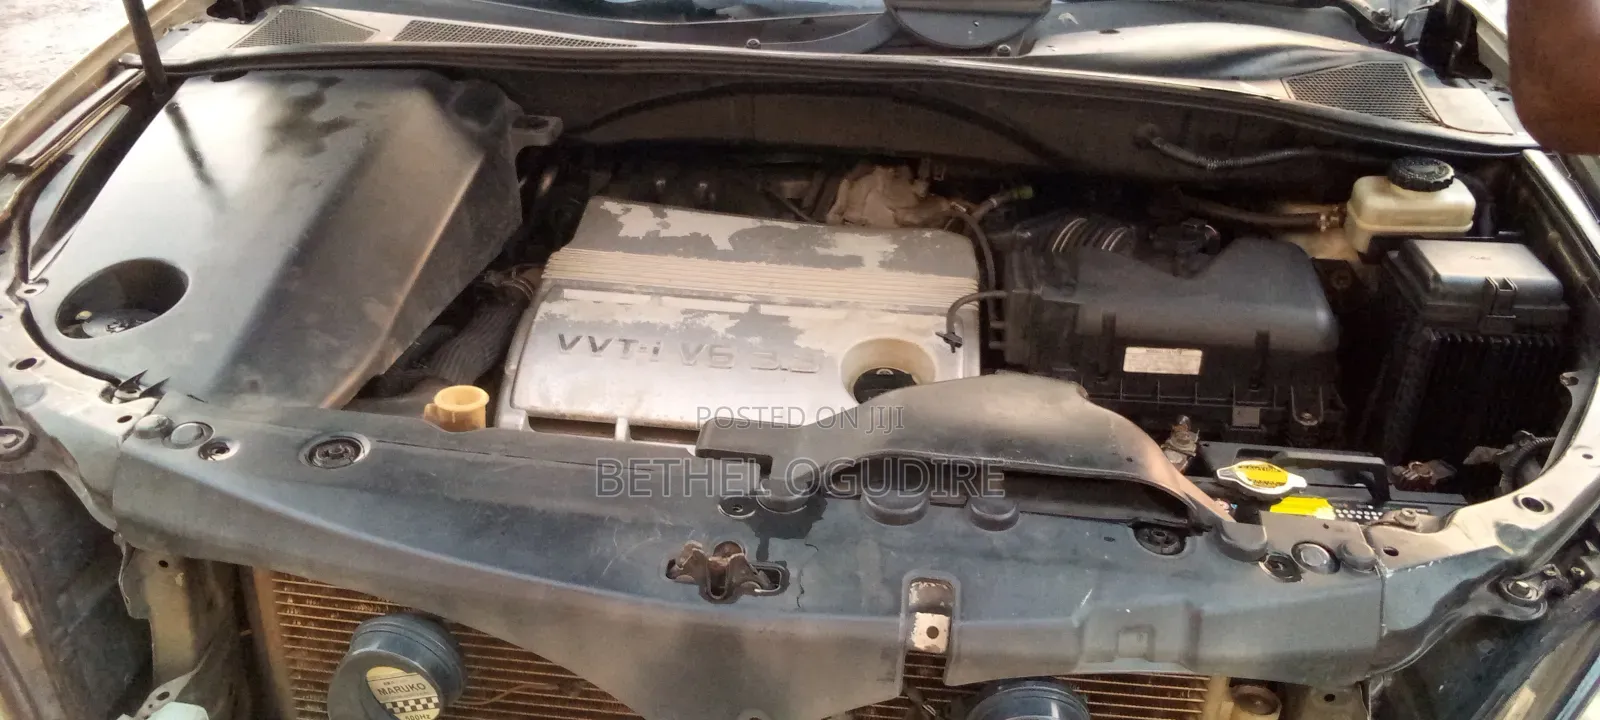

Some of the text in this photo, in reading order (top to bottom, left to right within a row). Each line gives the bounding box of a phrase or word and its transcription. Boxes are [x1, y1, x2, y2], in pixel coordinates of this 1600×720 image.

[558, 333, 661, 362] VVT-i
[680, 343, 735, 369] V6
[377, 682, 426, 696] MARUKO
